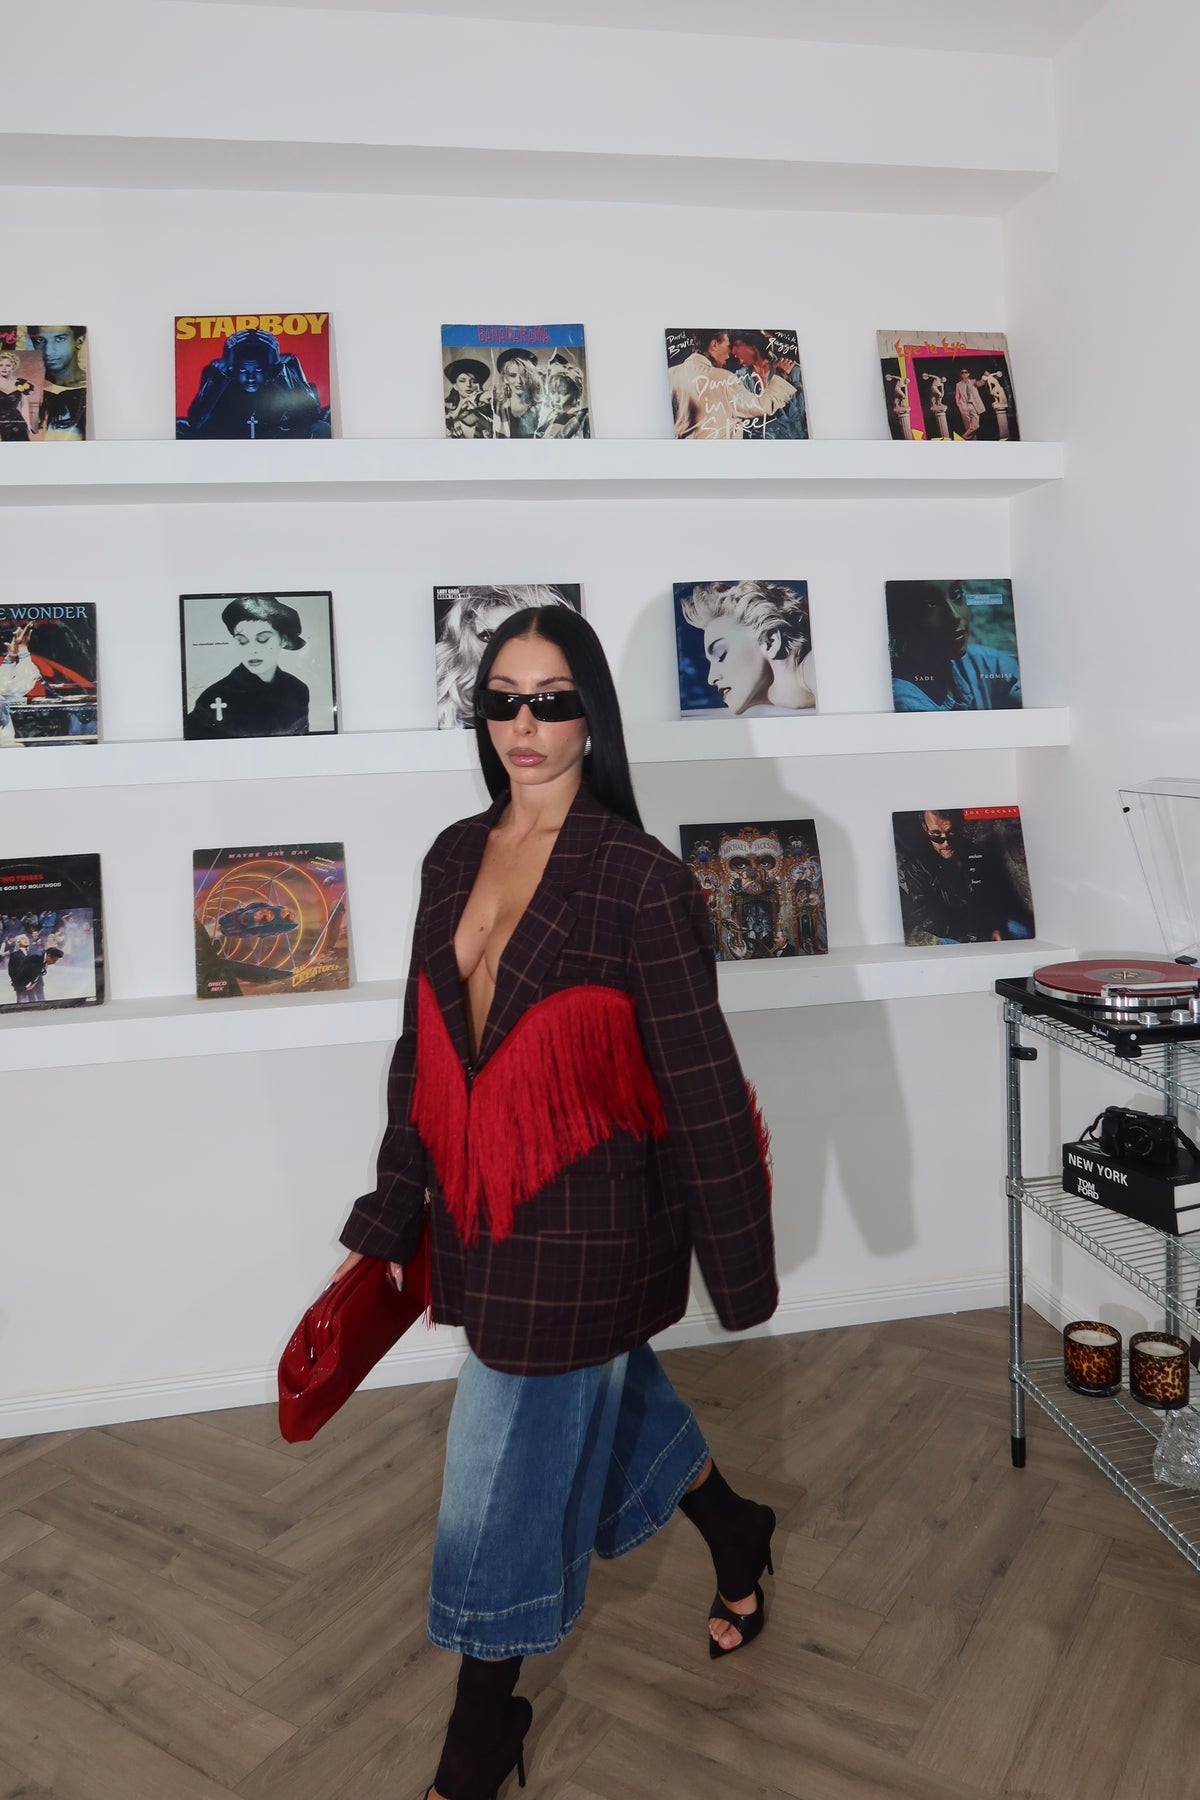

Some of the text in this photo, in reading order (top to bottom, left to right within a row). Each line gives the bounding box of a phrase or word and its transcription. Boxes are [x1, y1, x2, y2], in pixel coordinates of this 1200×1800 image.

[176, 313, 328, 340] STARBOY
[477, 325, 551, 344] BANANARAMA
[693, 371, 765, 398] Dancing
[704, 397, 726, 414] in
[9, 606, 88, 620] WONDER
[16, 873, 45, 881] TRIBES
[1068, 1153, 1129, 1187] NEW YORK
[1077, 1177, 1096, 1192] TOM
[1077, 1184, 1100, 1200] FORD
